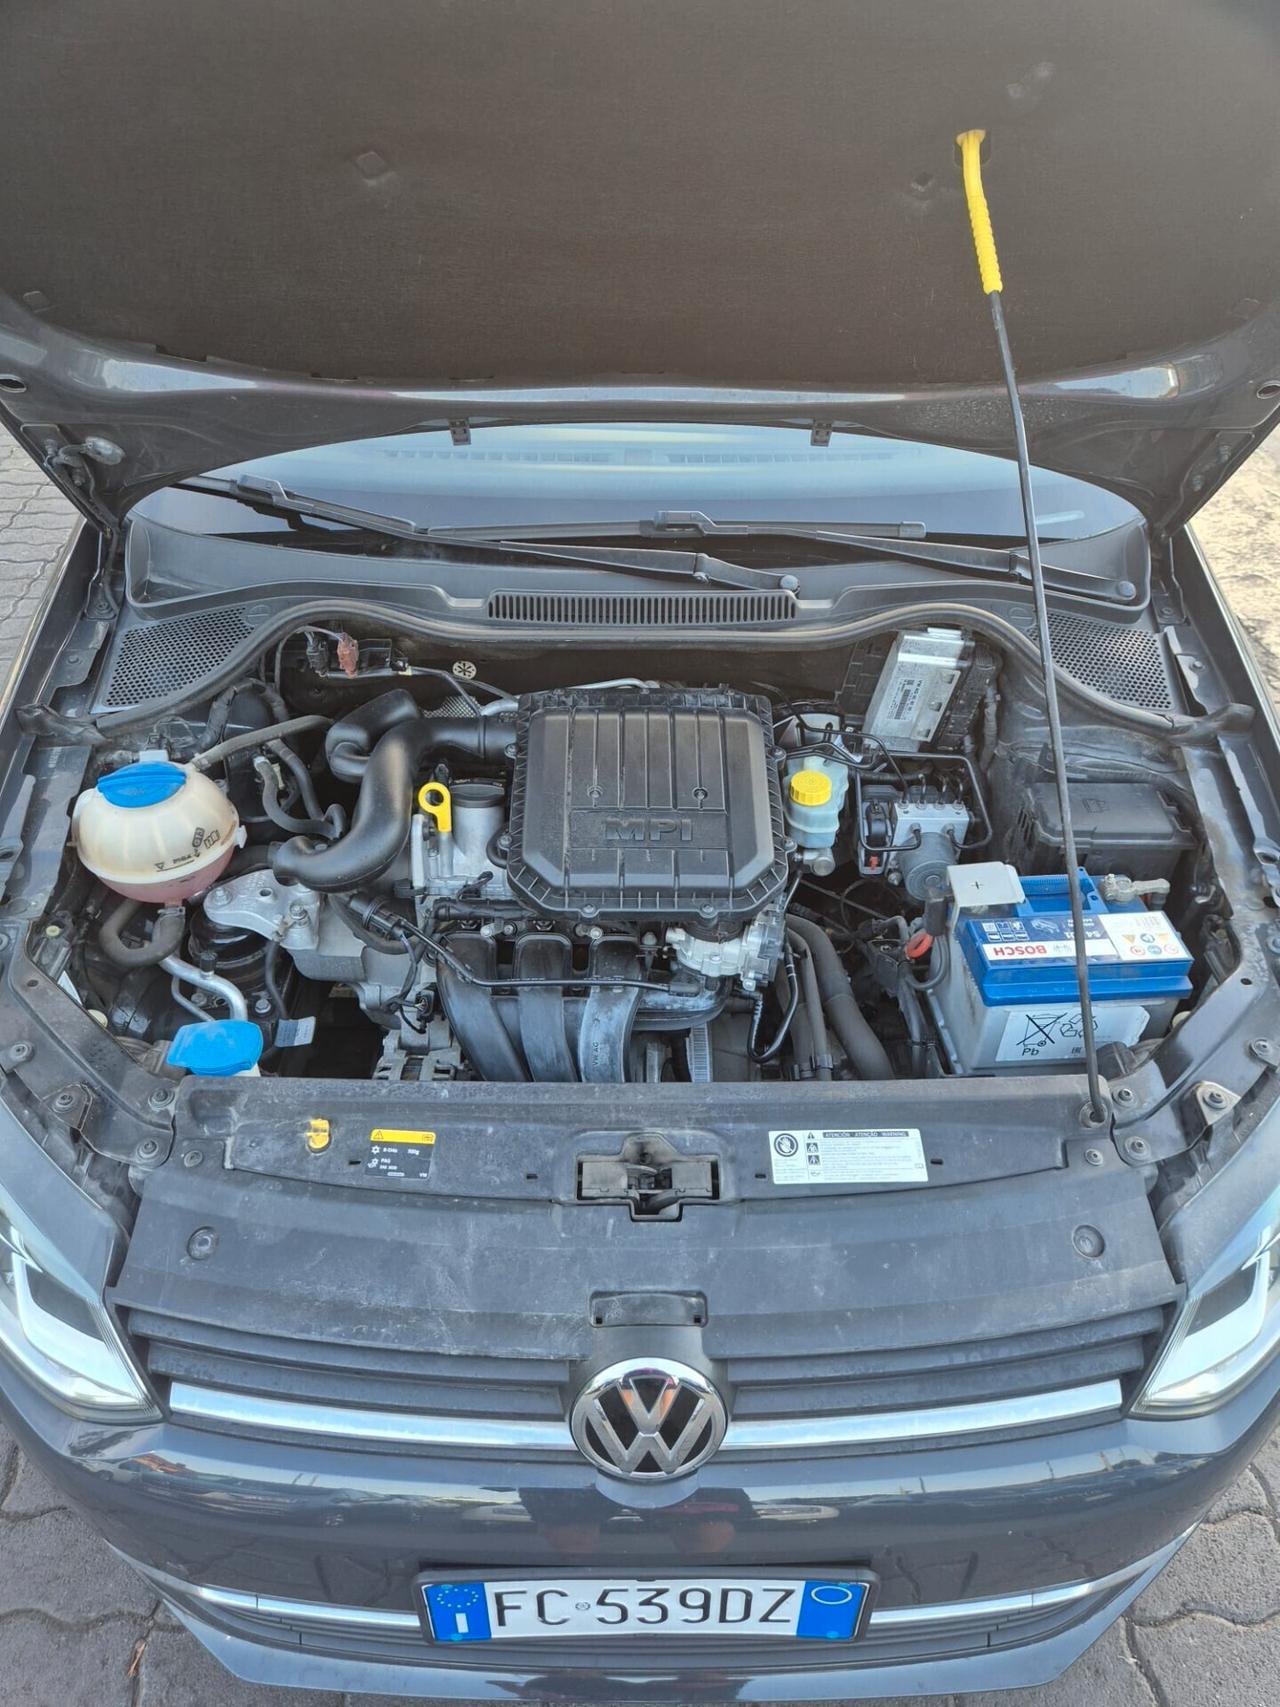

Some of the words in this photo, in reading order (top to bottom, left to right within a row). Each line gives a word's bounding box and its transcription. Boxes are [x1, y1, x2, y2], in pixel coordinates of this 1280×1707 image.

[605, 818, 693, 841] MPI
[993, 943, 1047, 957] BOSCH
[1022, 1047, 1039, 1056] Pb
[494, 1587, 569, 1627] FC
[595, 1587, 797, 1625] 539DZ
